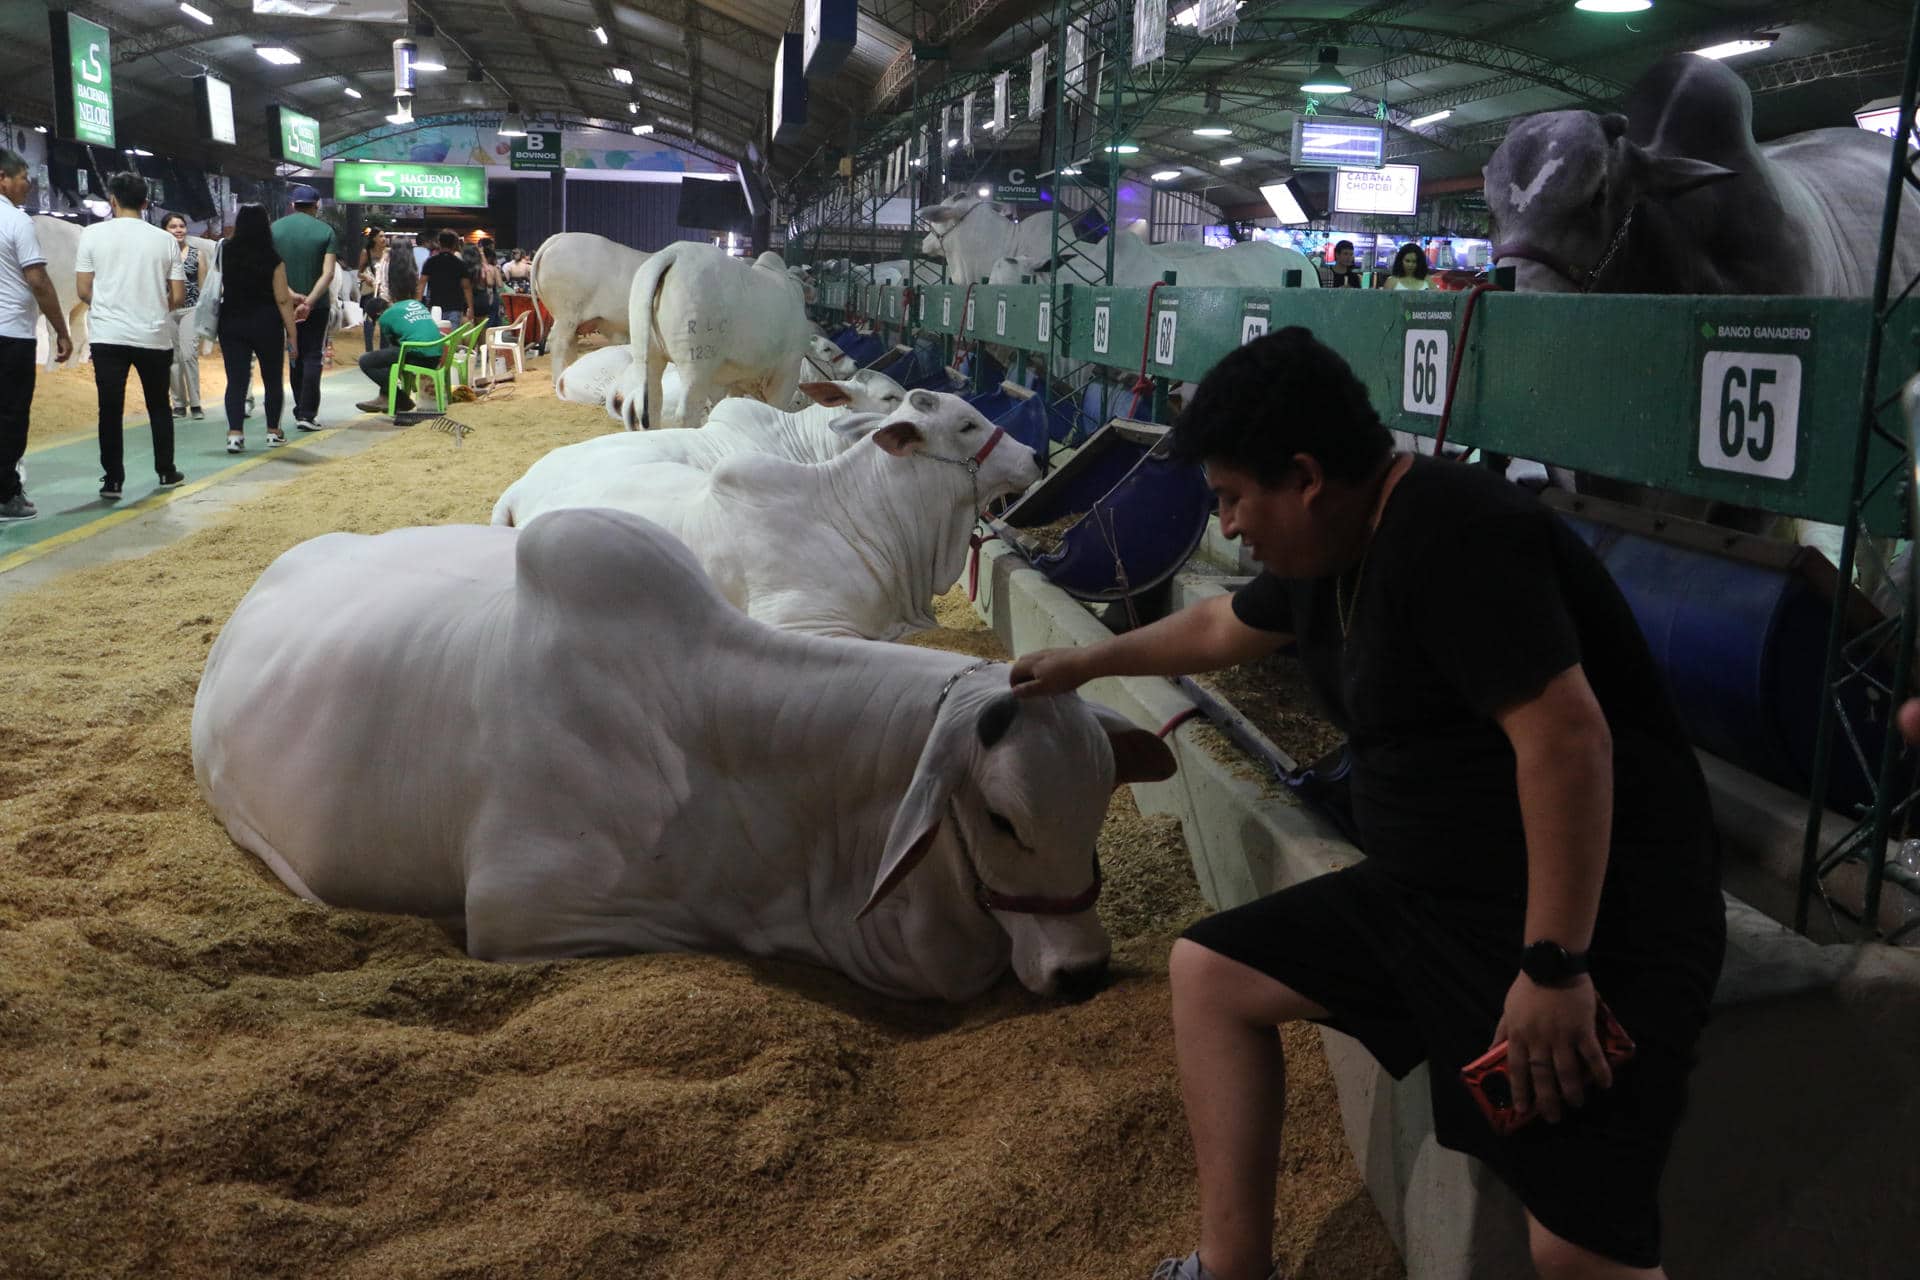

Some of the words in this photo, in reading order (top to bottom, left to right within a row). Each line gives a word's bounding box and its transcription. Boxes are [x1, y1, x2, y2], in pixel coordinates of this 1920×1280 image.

[528, 134, 544, 150] B
[515, 152, 557, 160] BOVINOS
[400, 173, 461, 186] HACIENDA
[1008, 169, 1025, 185] C
[998, 185, 1036, 193] BOVINOS
[1097, 312, 1107, 348] 69
[1160, 316, 1172, 359] 68
[1718, 326, 1751, 338] BANCO
[1752, 327, 1811, 340] GANADERO
[1412, 338, 1438, 405] 66
[1719, 365, 1777, 463] 65
